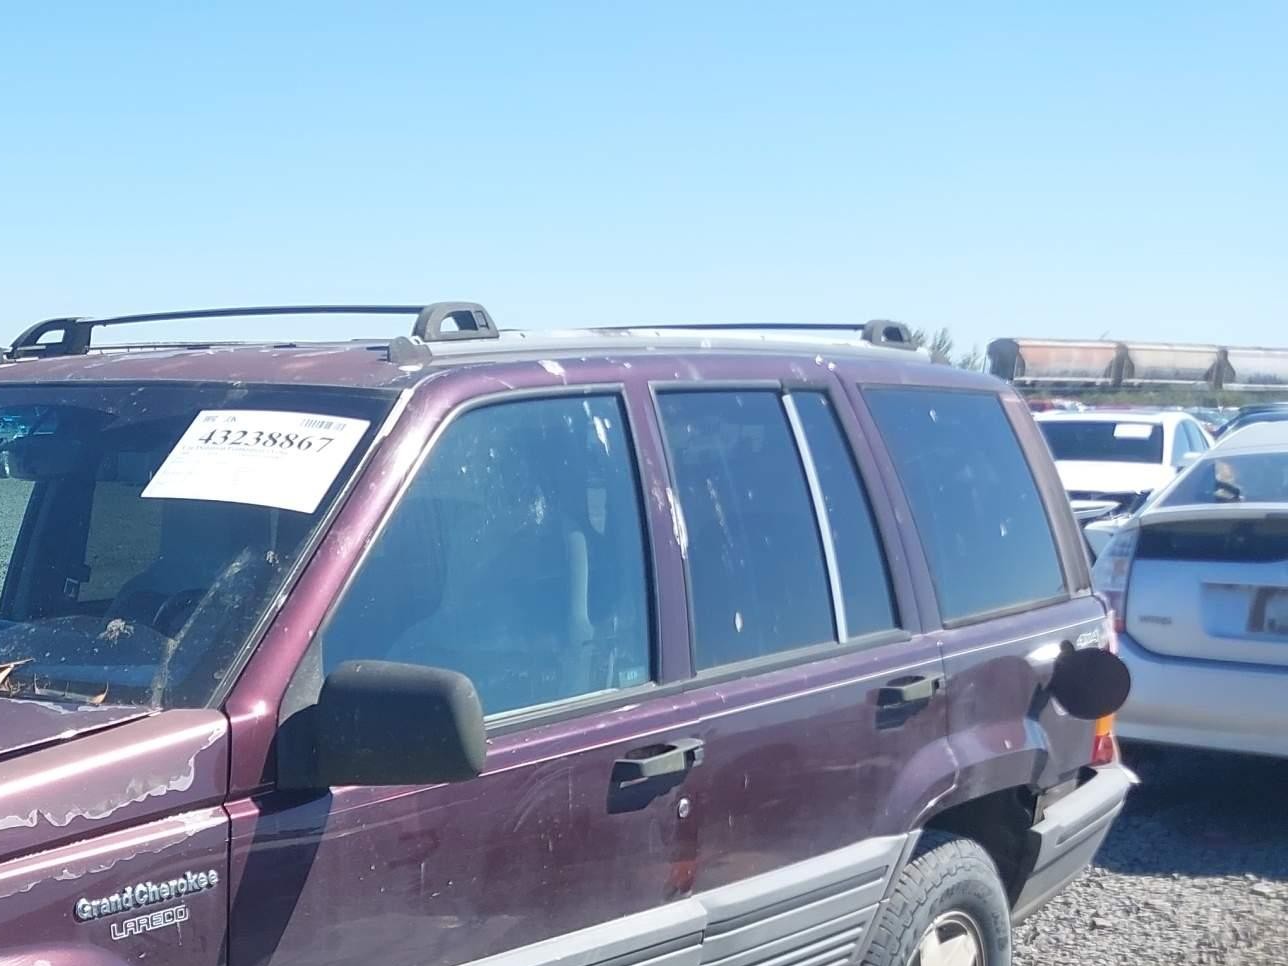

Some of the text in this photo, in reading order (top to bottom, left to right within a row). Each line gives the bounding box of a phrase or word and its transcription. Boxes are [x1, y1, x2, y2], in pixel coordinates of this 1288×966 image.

[198, 429, 334, 453] 43238867
[75, 869, 218, 921] Grand Cherokee
[111, 905, 189, 940] LAREDO
